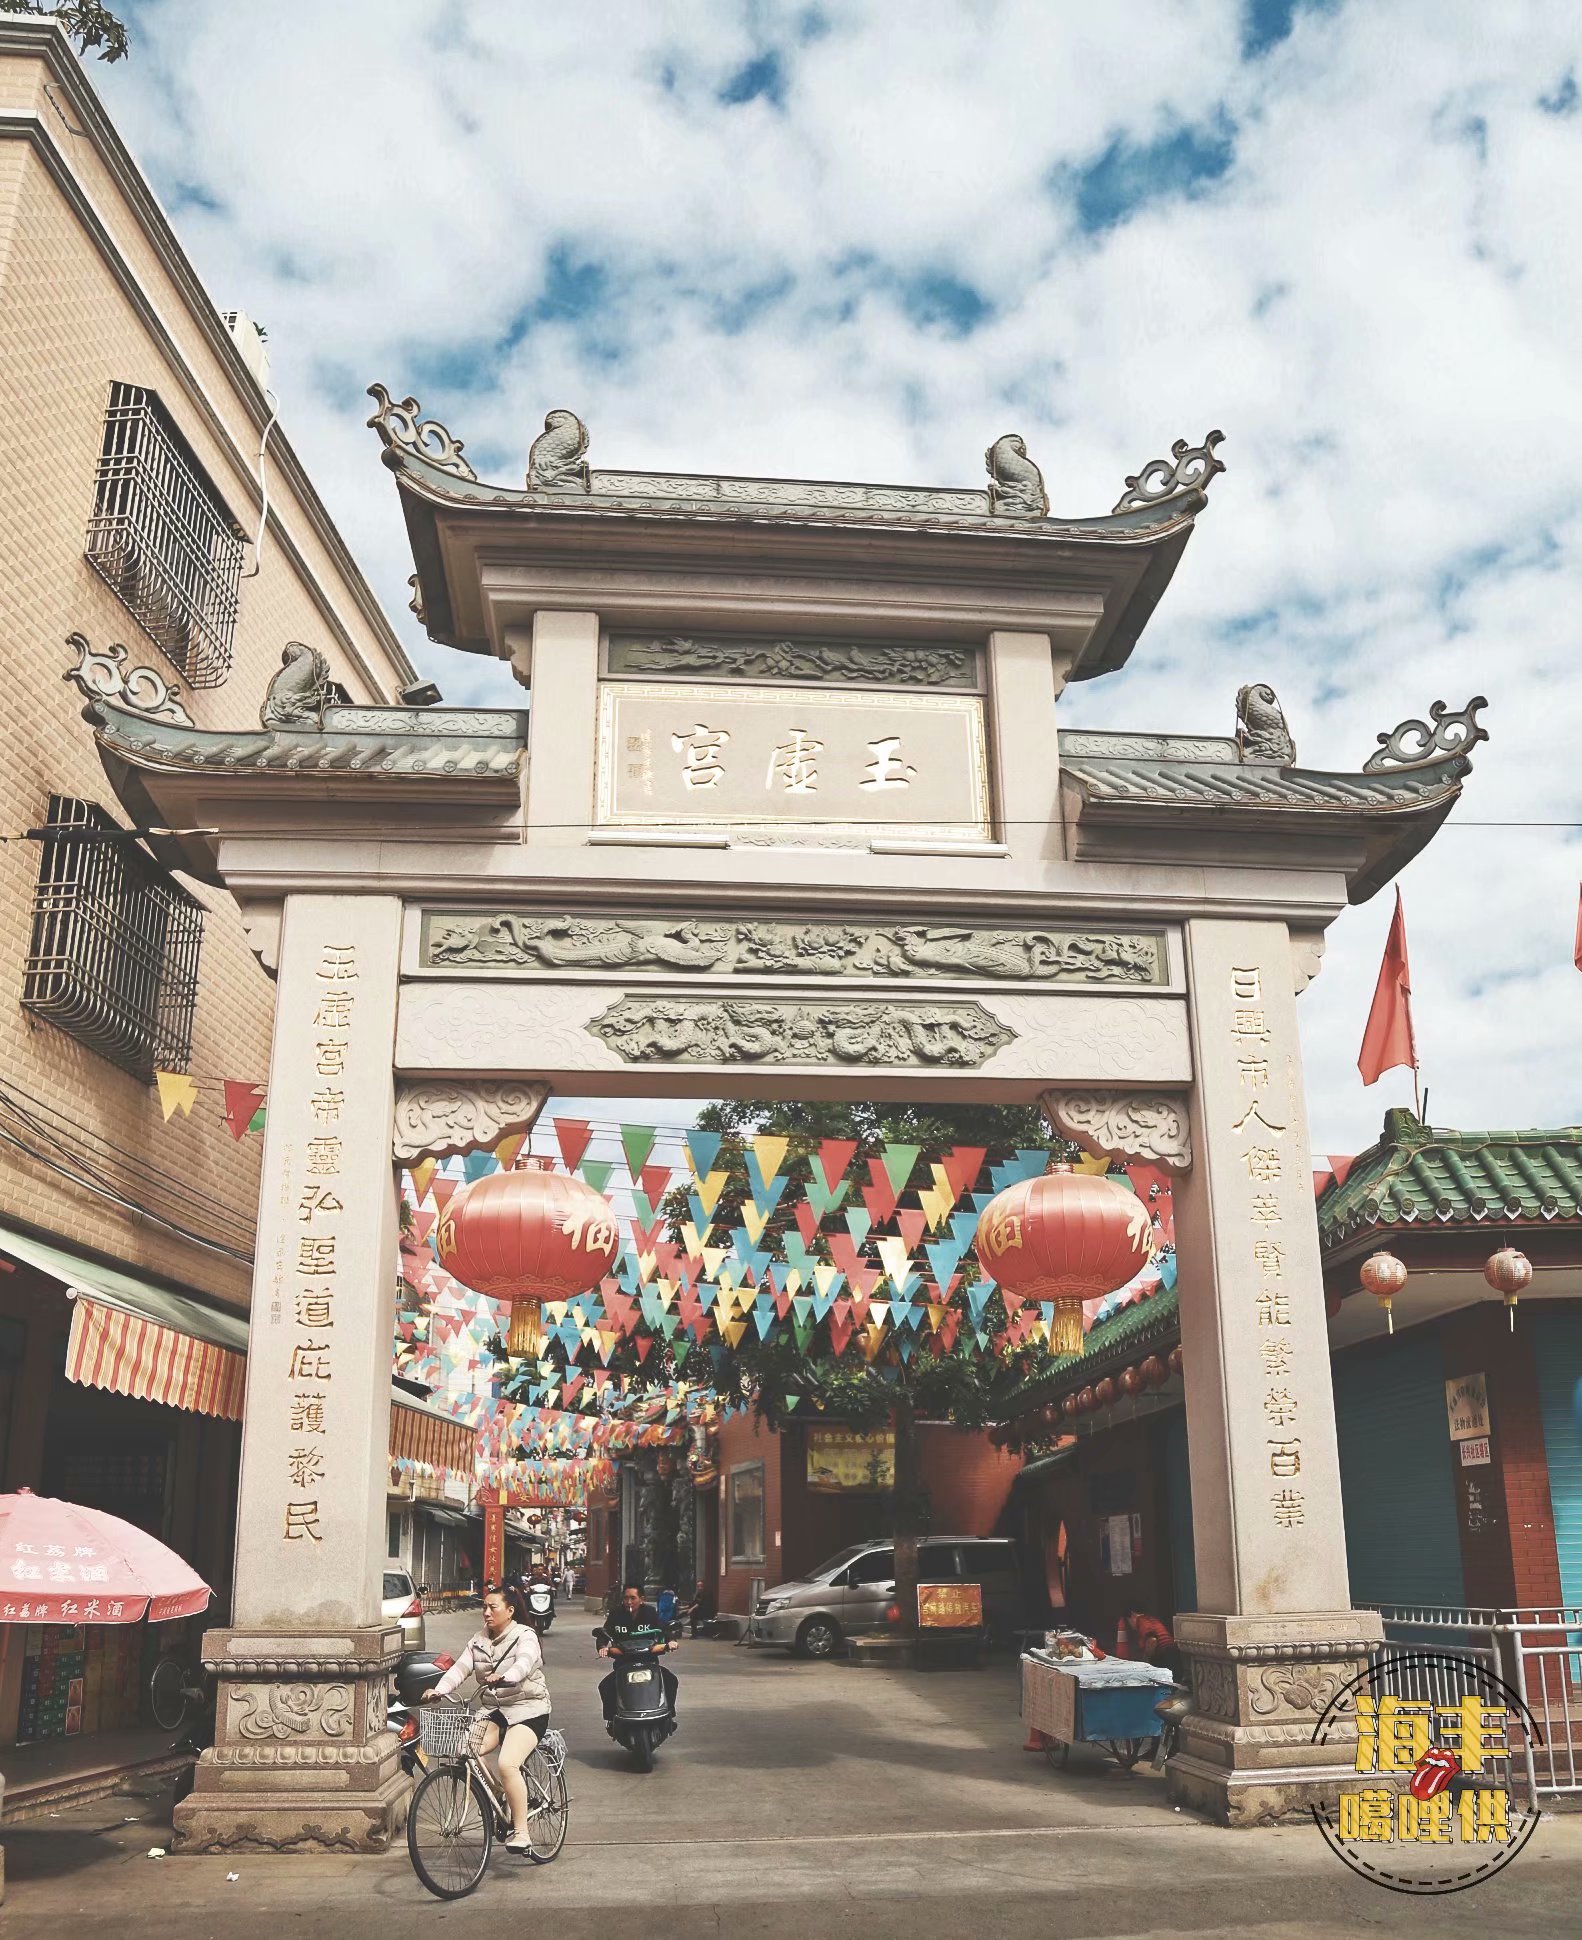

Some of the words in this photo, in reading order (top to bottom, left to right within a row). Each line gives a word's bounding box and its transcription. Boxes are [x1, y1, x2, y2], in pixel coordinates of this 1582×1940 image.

[3, 1602, 49, 1618] 红荔牌
[61, 1598, 125, 1620] 红米酒
